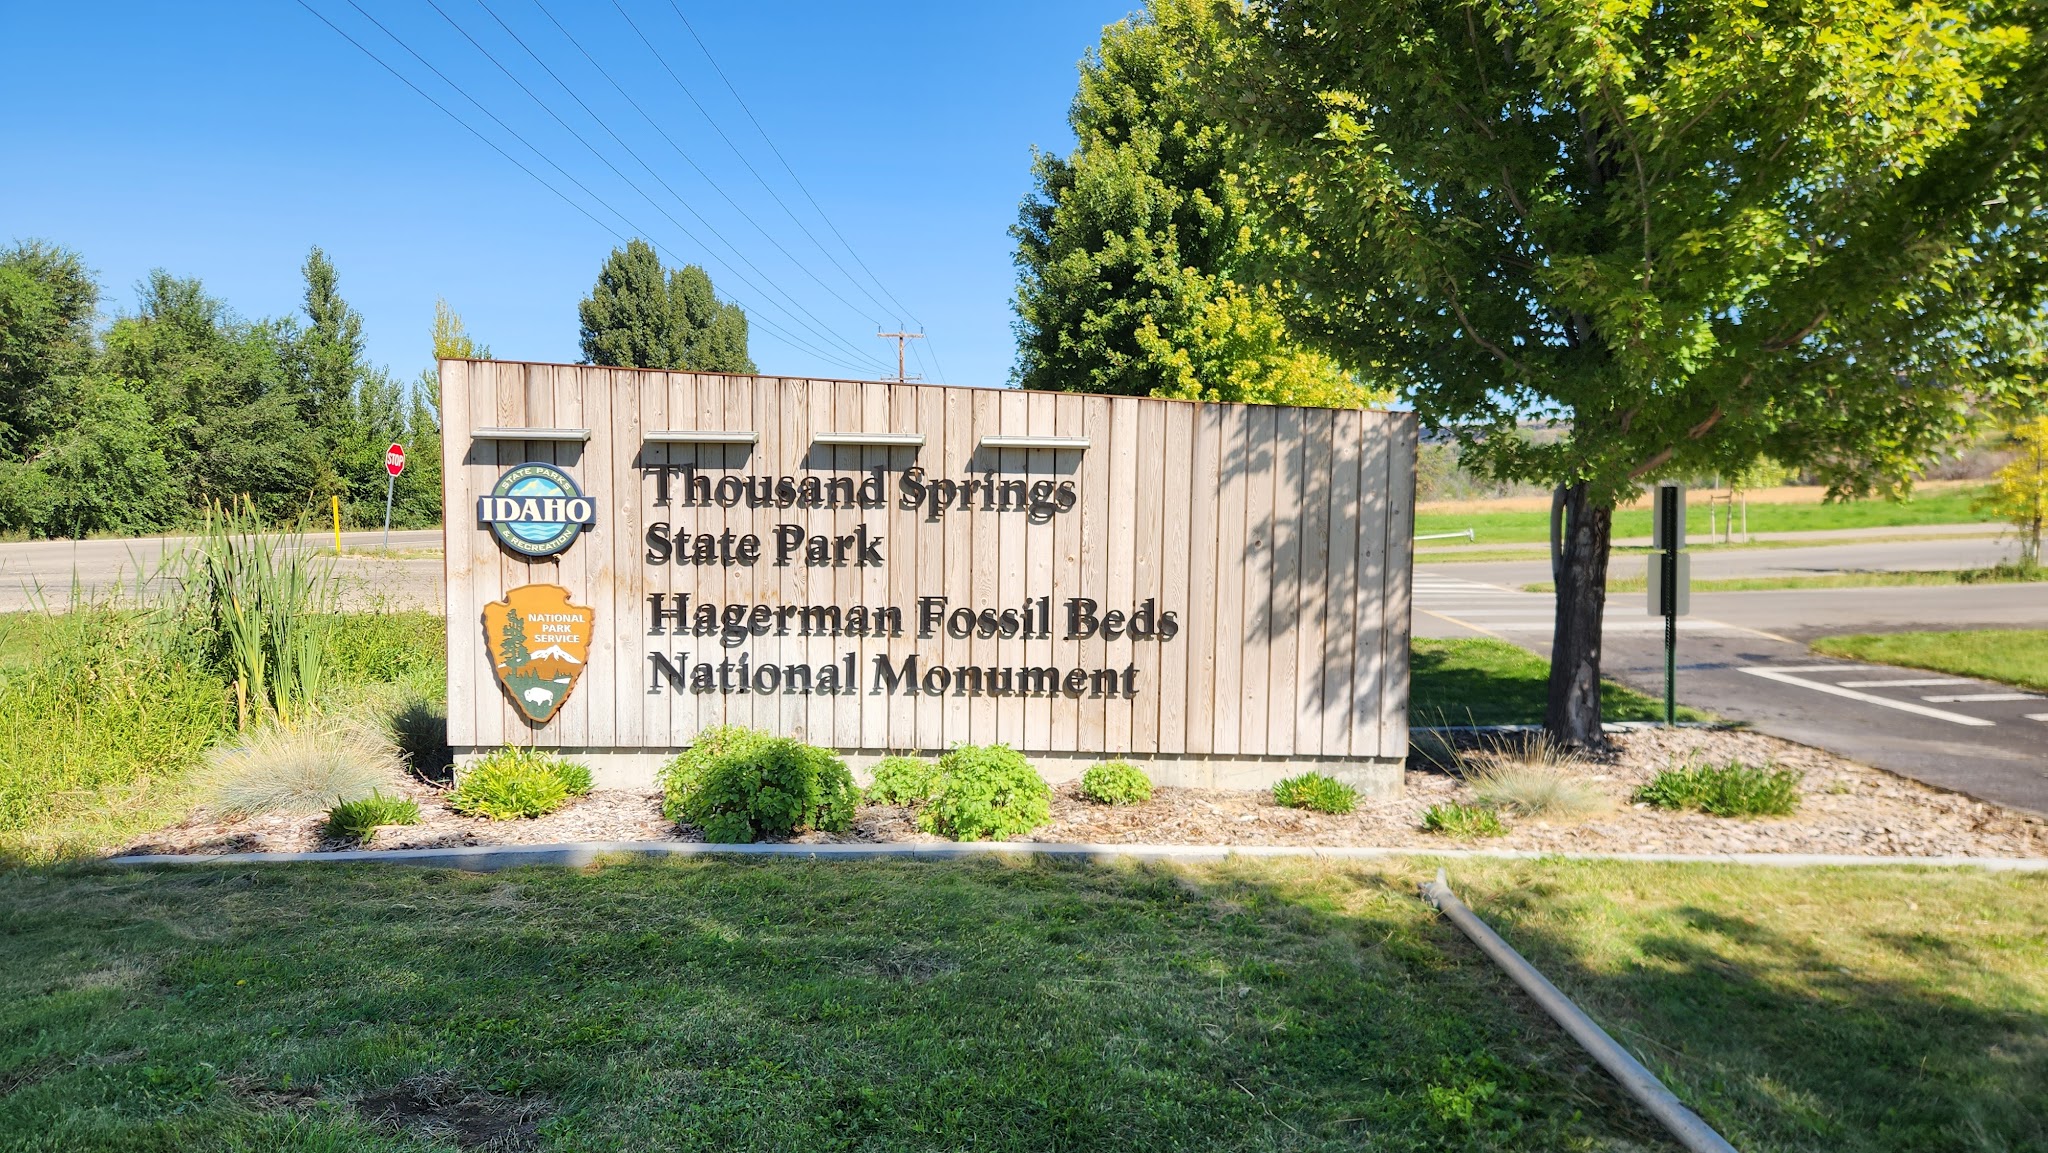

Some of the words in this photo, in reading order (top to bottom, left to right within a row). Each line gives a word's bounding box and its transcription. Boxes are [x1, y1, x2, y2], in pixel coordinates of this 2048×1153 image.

[387, 452, 404, 467] STOP
[501, 467, 532, 490] STATE
[536, 468, 571, 491] PARKS
[644, 463, 887, 504] Thousand
[901, 466, 1077, 519] Springs
[481, 497, 592, 523] IDAHO
[502, 530, 510, 538] &
[510, 529, 572, 552] RECREATION
[648, 521, 761, 562] State
[775, 523, 885, 562] Park
[528, 613, 586, 623] NATIONAL
[542, 624, 571, 633] PARK
[649, 592, 904, 643] Hagerman
[919, 596, 1052, 635] Fossil
[1066, 597, 1179, 637] Beds
[534, 634, 580, 643] SERVICE
[649, 651, 859, 692] National
[873, 653, 1140, 696] Monument
